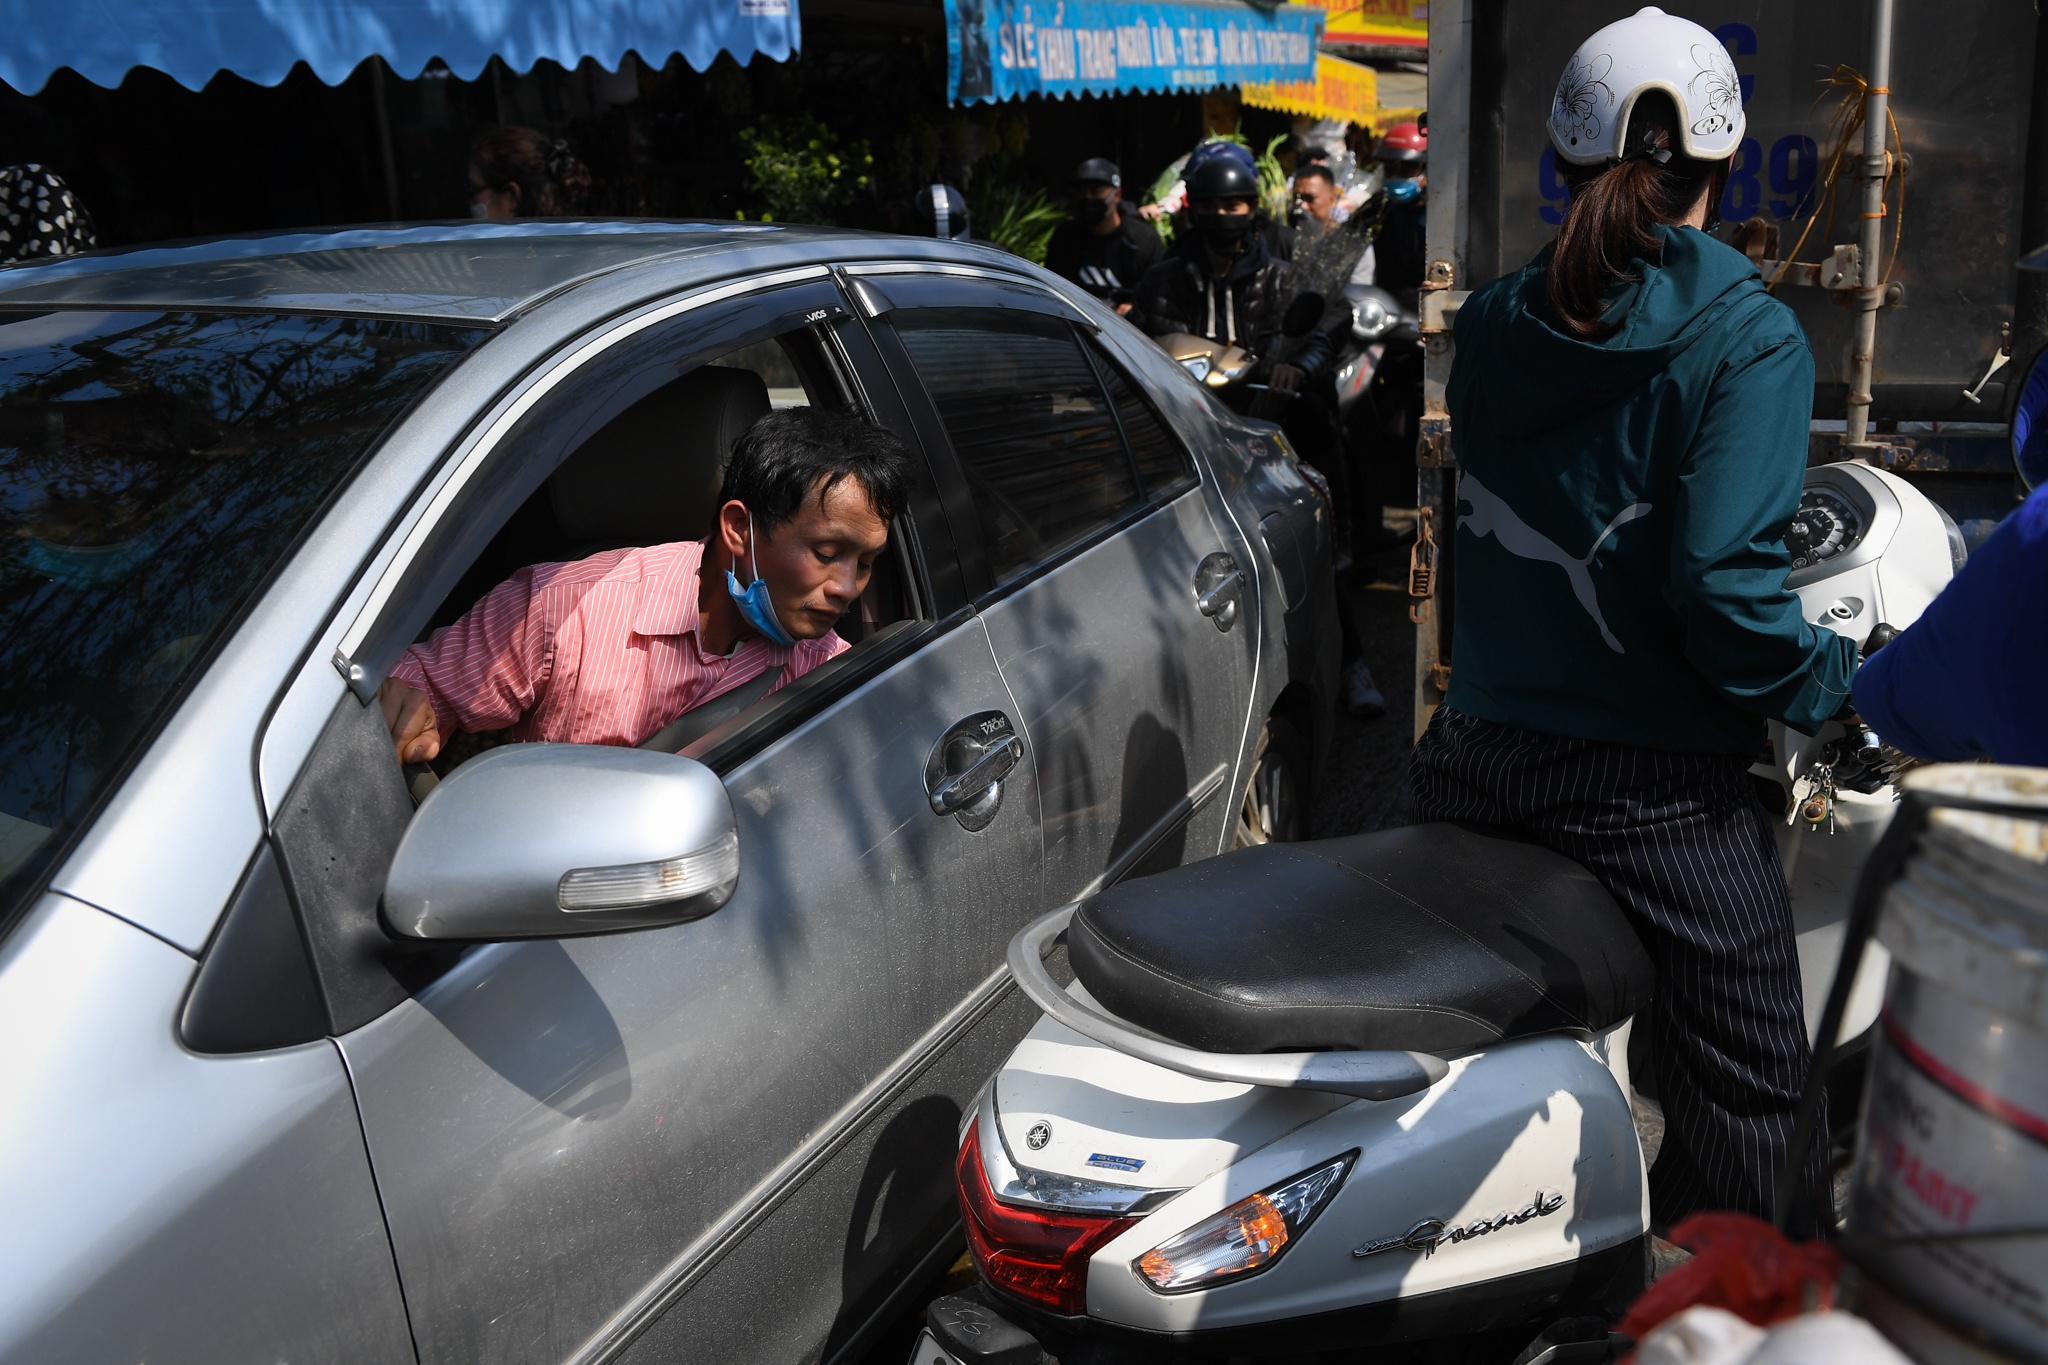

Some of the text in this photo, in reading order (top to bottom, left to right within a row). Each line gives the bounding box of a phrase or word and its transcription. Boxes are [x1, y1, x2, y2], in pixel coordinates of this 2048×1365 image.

[805, 309, 828, 322] VIOS
[1097, 1154, 1137, 1165] BLUE
[1092, 1161, 1132, 1172] CORE
[1353, 1189, 1568, 1260] Grande
